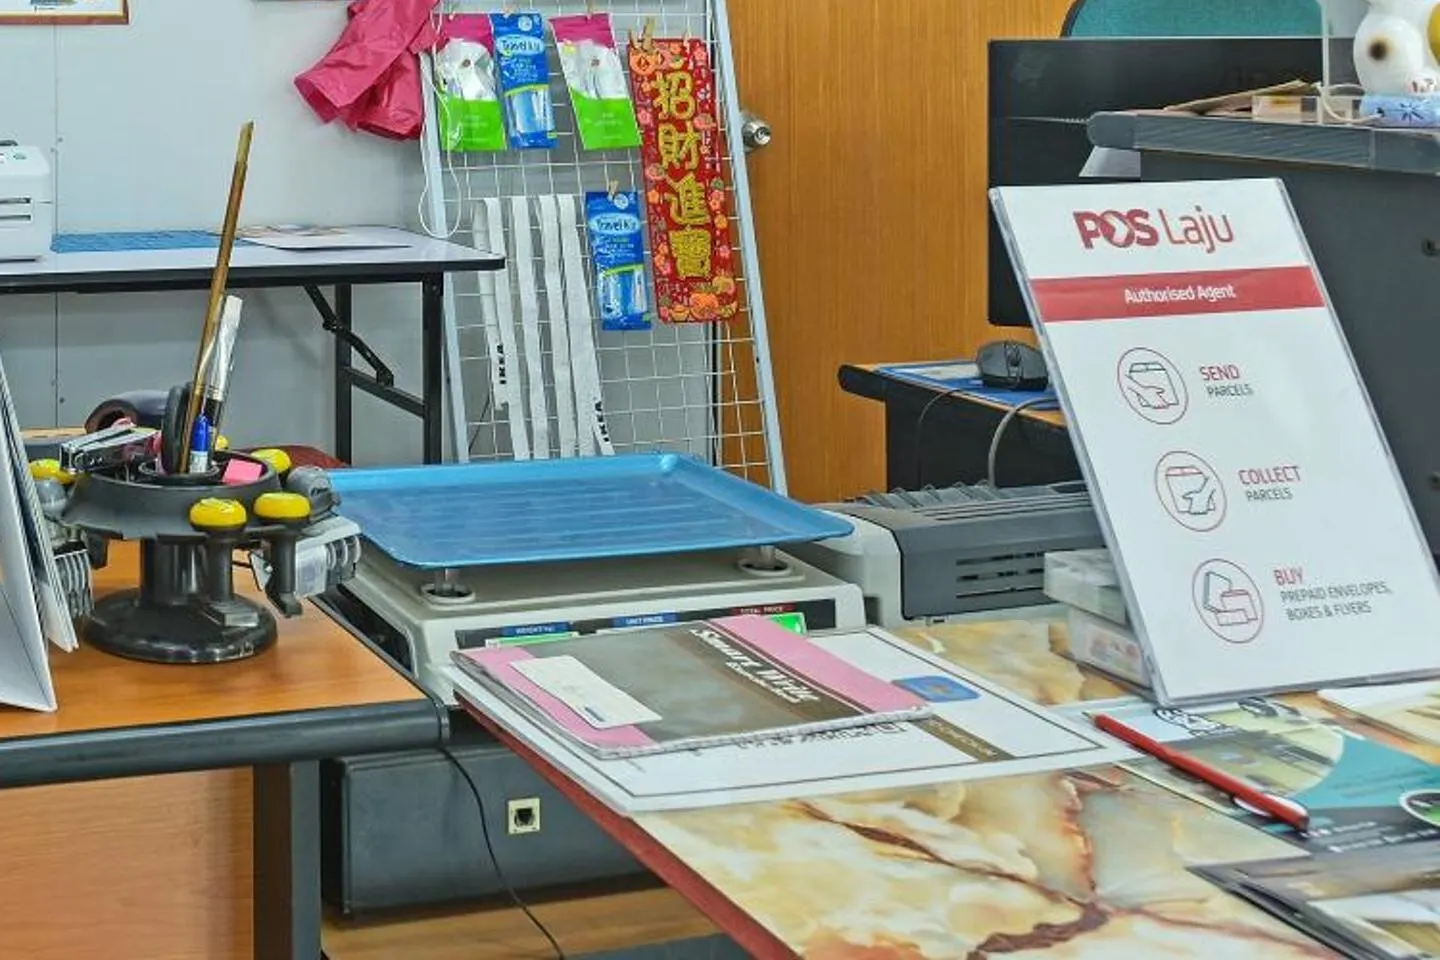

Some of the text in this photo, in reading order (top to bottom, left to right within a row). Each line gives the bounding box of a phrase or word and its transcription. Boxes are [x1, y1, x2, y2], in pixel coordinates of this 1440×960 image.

[1073, 205, 1234, 253] POS Laju
[1124, 284, 1237, 303] Authorised Agent
[1200, 364, 1240, 381] SEND
[1206, 383, 1253, 397] PARCELS
[1238, 466, 1301, 485] COLLECT
[1246, 488, 1293, 502] PARCELS
[1274, 567, 1303, 586] BUY
[1280, 587, 1326, 602] PREPAID
